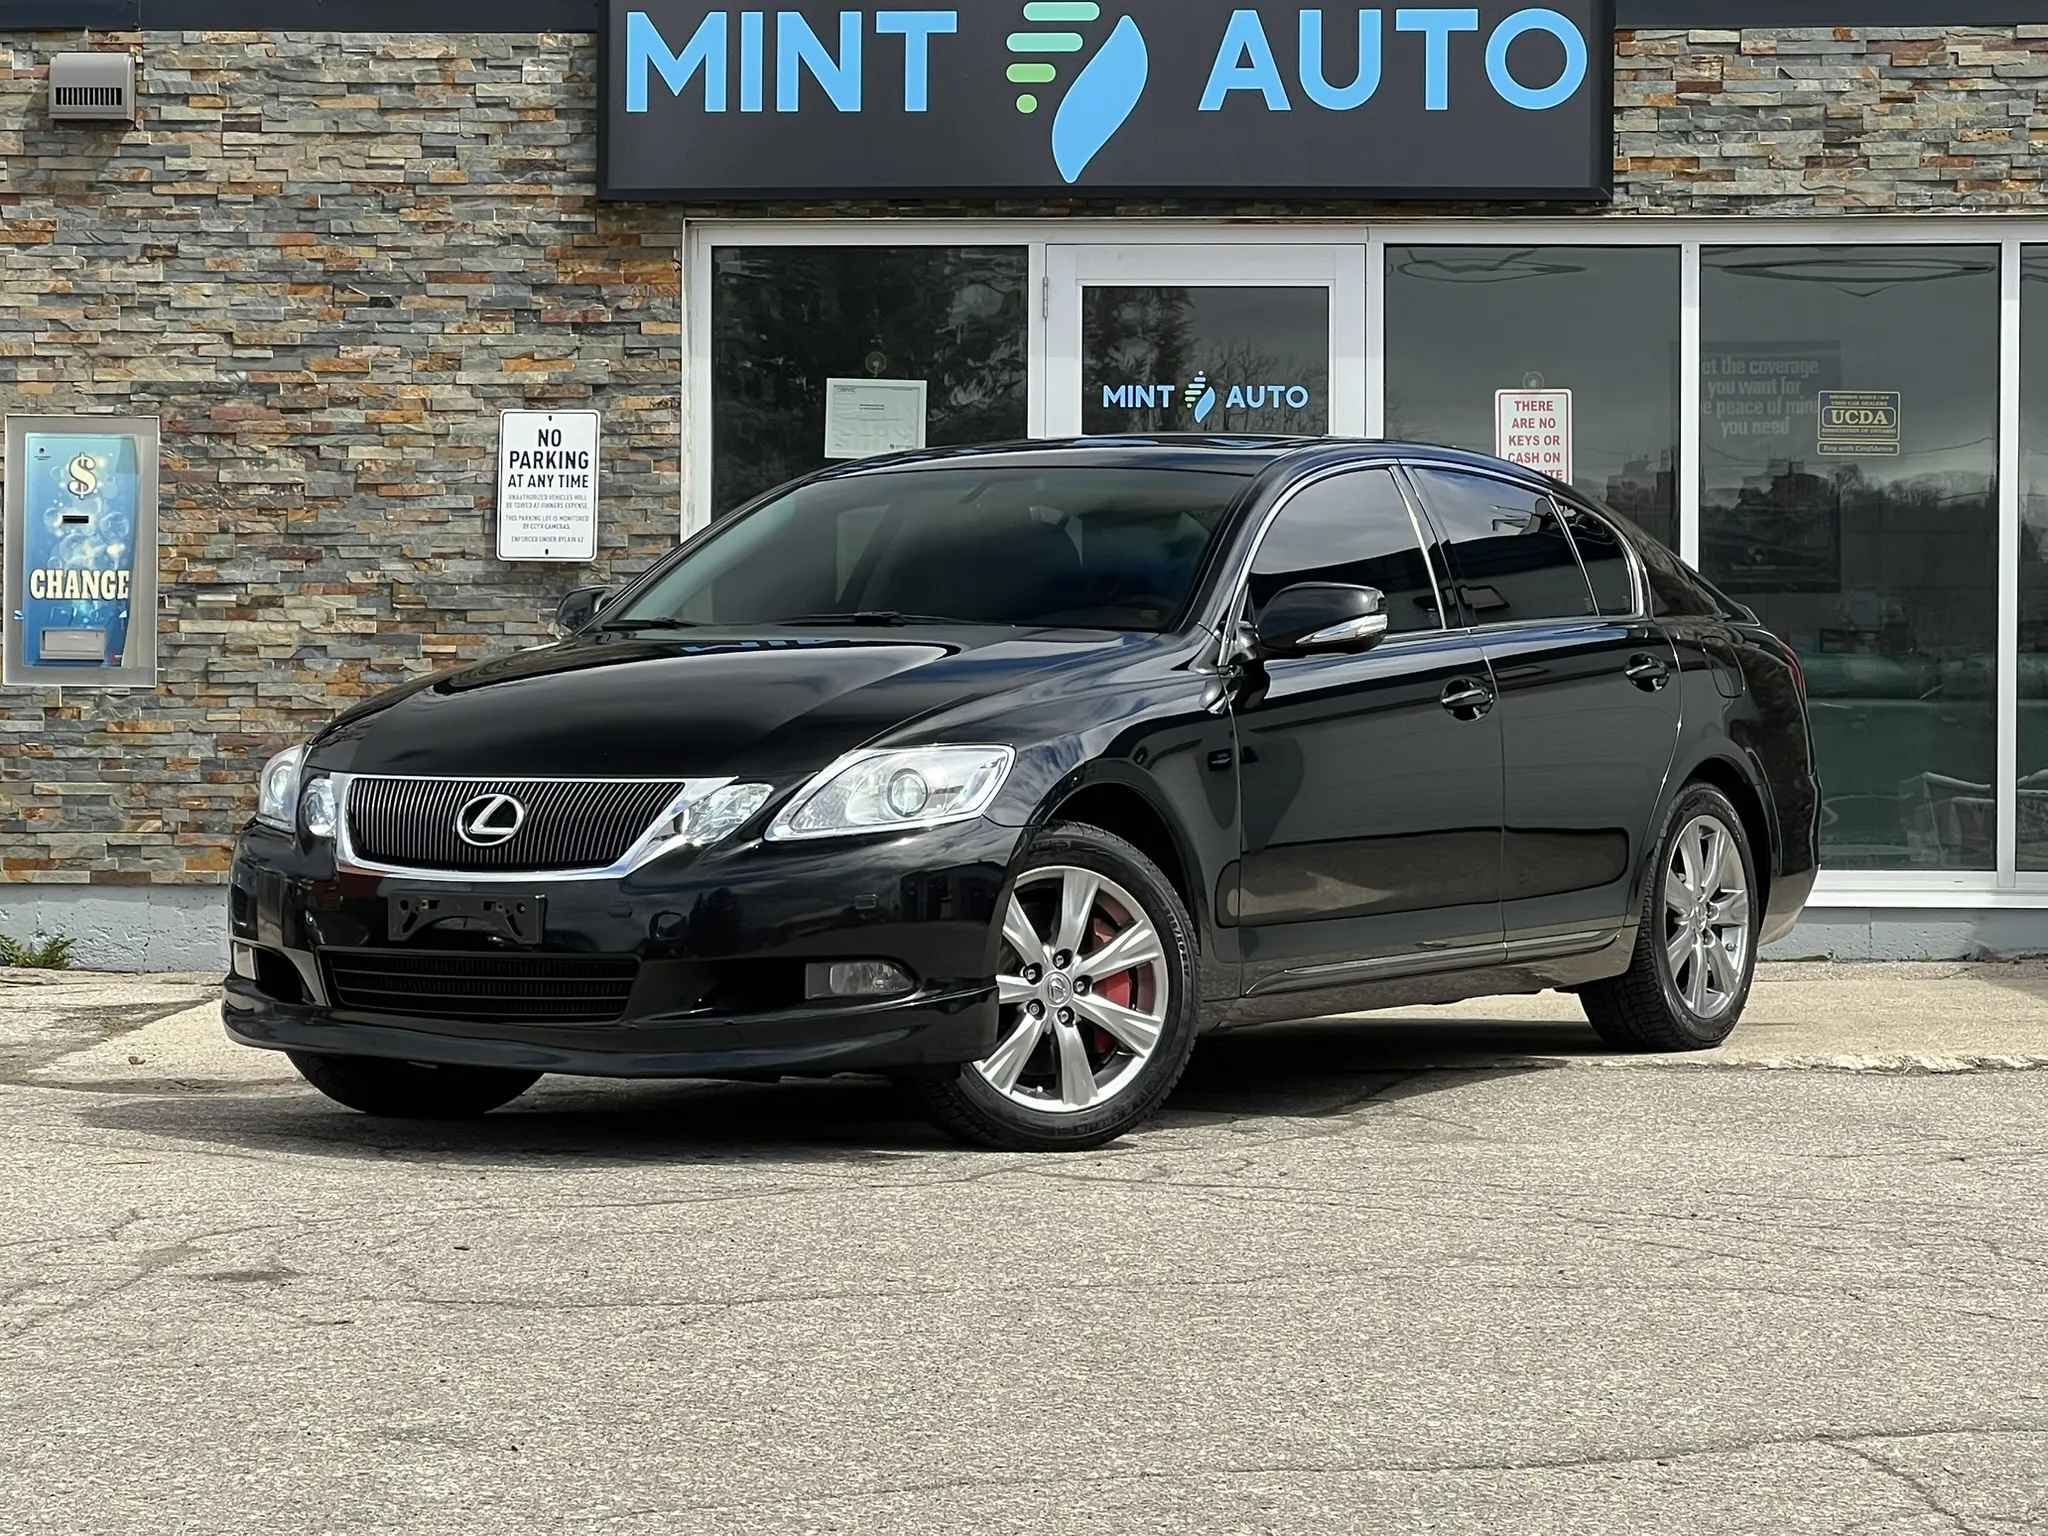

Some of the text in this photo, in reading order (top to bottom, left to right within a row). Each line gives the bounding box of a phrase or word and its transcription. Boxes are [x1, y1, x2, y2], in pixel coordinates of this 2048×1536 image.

[625, 7, 1588, 113] MINT AUTO
[1721, 356, 1745, 374] the
[1749, 360, 1819, 379] coverage
[1102, 385, 1309, 409] MINT AUTO
[1708, 376, 1801, 399] you want for
[1514, 400, 1554, 411] THERE
[1716, 400, 1762, 419] peace
[1767, 396, 1783, 415] of
[1511, 418, 1556, 429] ARE NO
[1831, 409, 1888, 425] UCDA
[1721, 416, 1790, 439] you need
[538, 429, 562, 447] NO
[1508, 435, 1560, 446] KEYS OR
[509, 450, 589, 469] PARKING
[1508, 452, 1560, 463] CASH ON
[508, 474, 589, 488] AT ANY TIME
[29, 568, 130, 600] CHANGE
